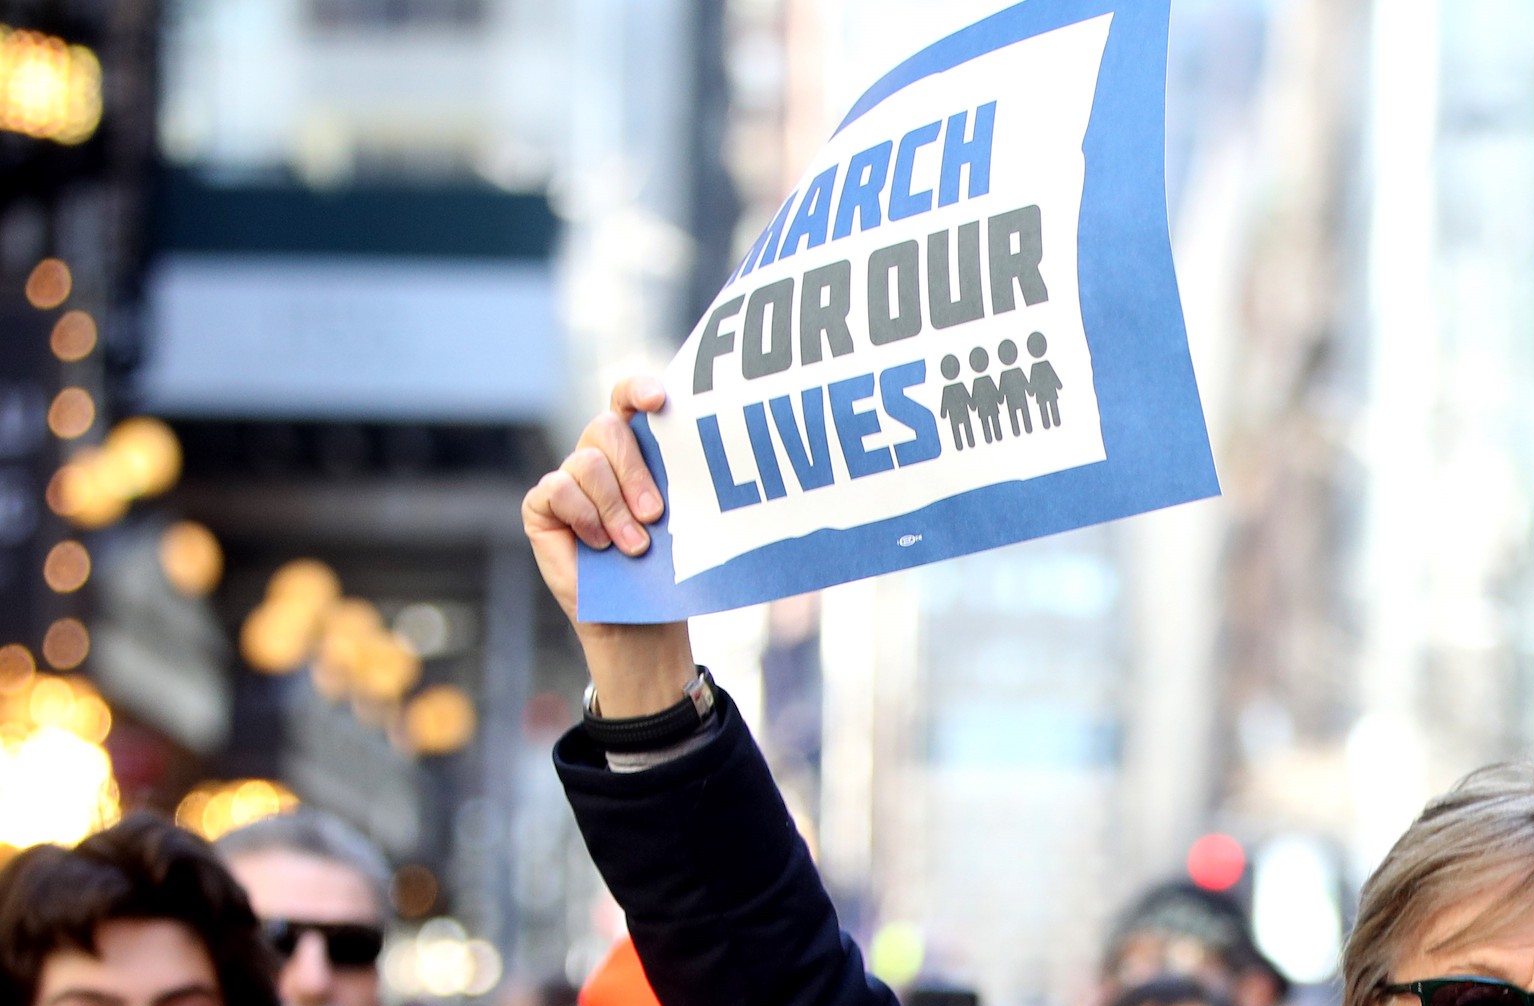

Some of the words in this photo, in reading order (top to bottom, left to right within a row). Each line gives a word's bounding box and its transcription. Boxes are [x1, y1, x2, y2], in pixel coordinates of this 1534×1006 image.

[693, 260, 854, 395] FOR
[868, 205, 1048, 346] OUR
[696, 359, 941, 513] LIVES
